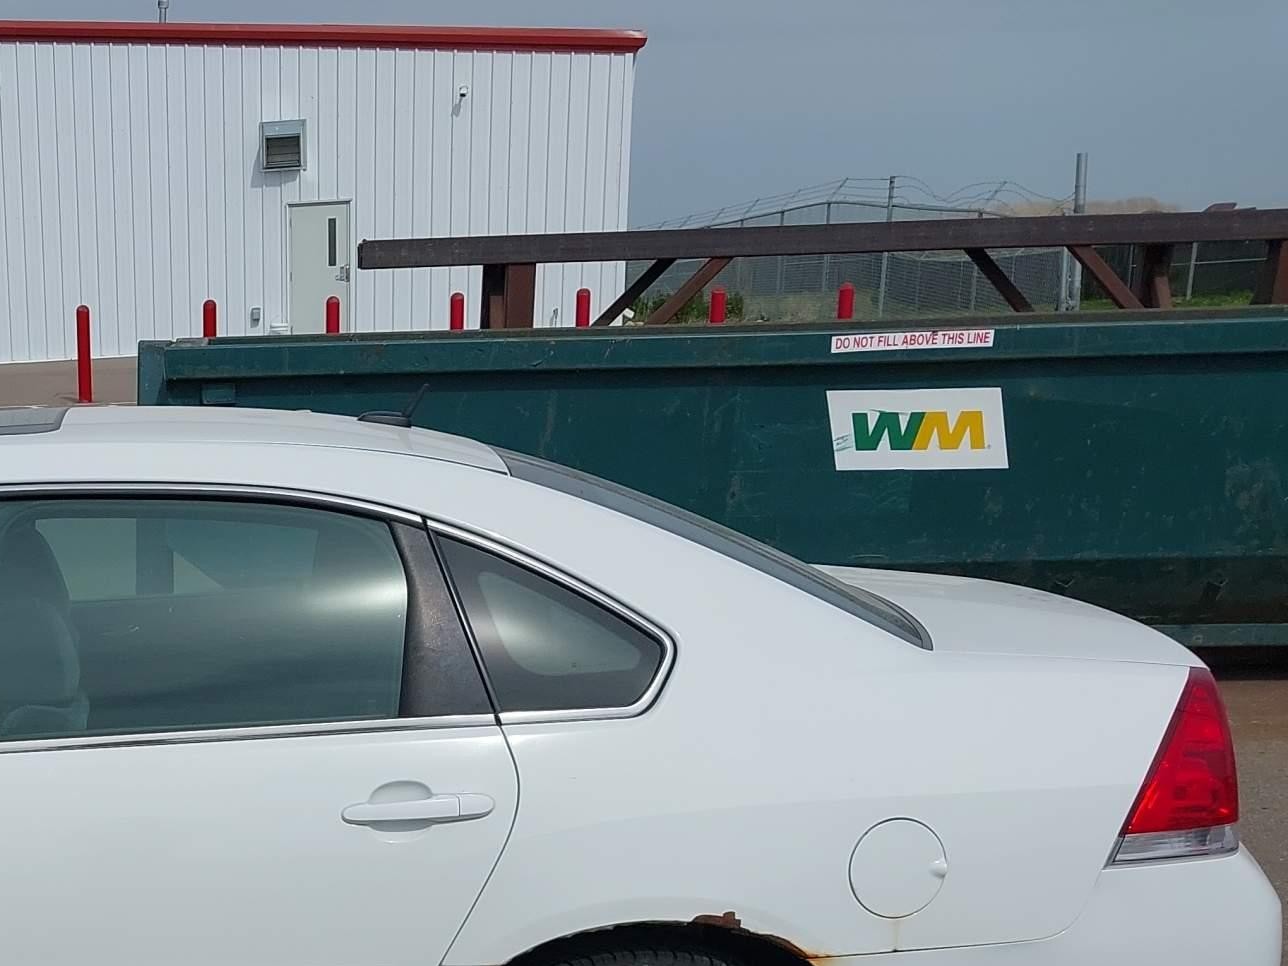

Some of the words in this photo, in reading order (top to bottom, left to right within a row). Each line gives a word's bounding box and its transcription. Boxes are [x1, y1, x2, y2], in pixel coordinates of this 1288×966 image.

[835, 337, 851, 350] DO
[853, 335, 875, 349] NOT
[877, 334, 899, 347] FILL
[902, 332, 939, 347] ABOVE
[941, 332, 964, 345] THIS
[967, 331, 991, 345] LINE
[852, 410, 985, 451] WM
